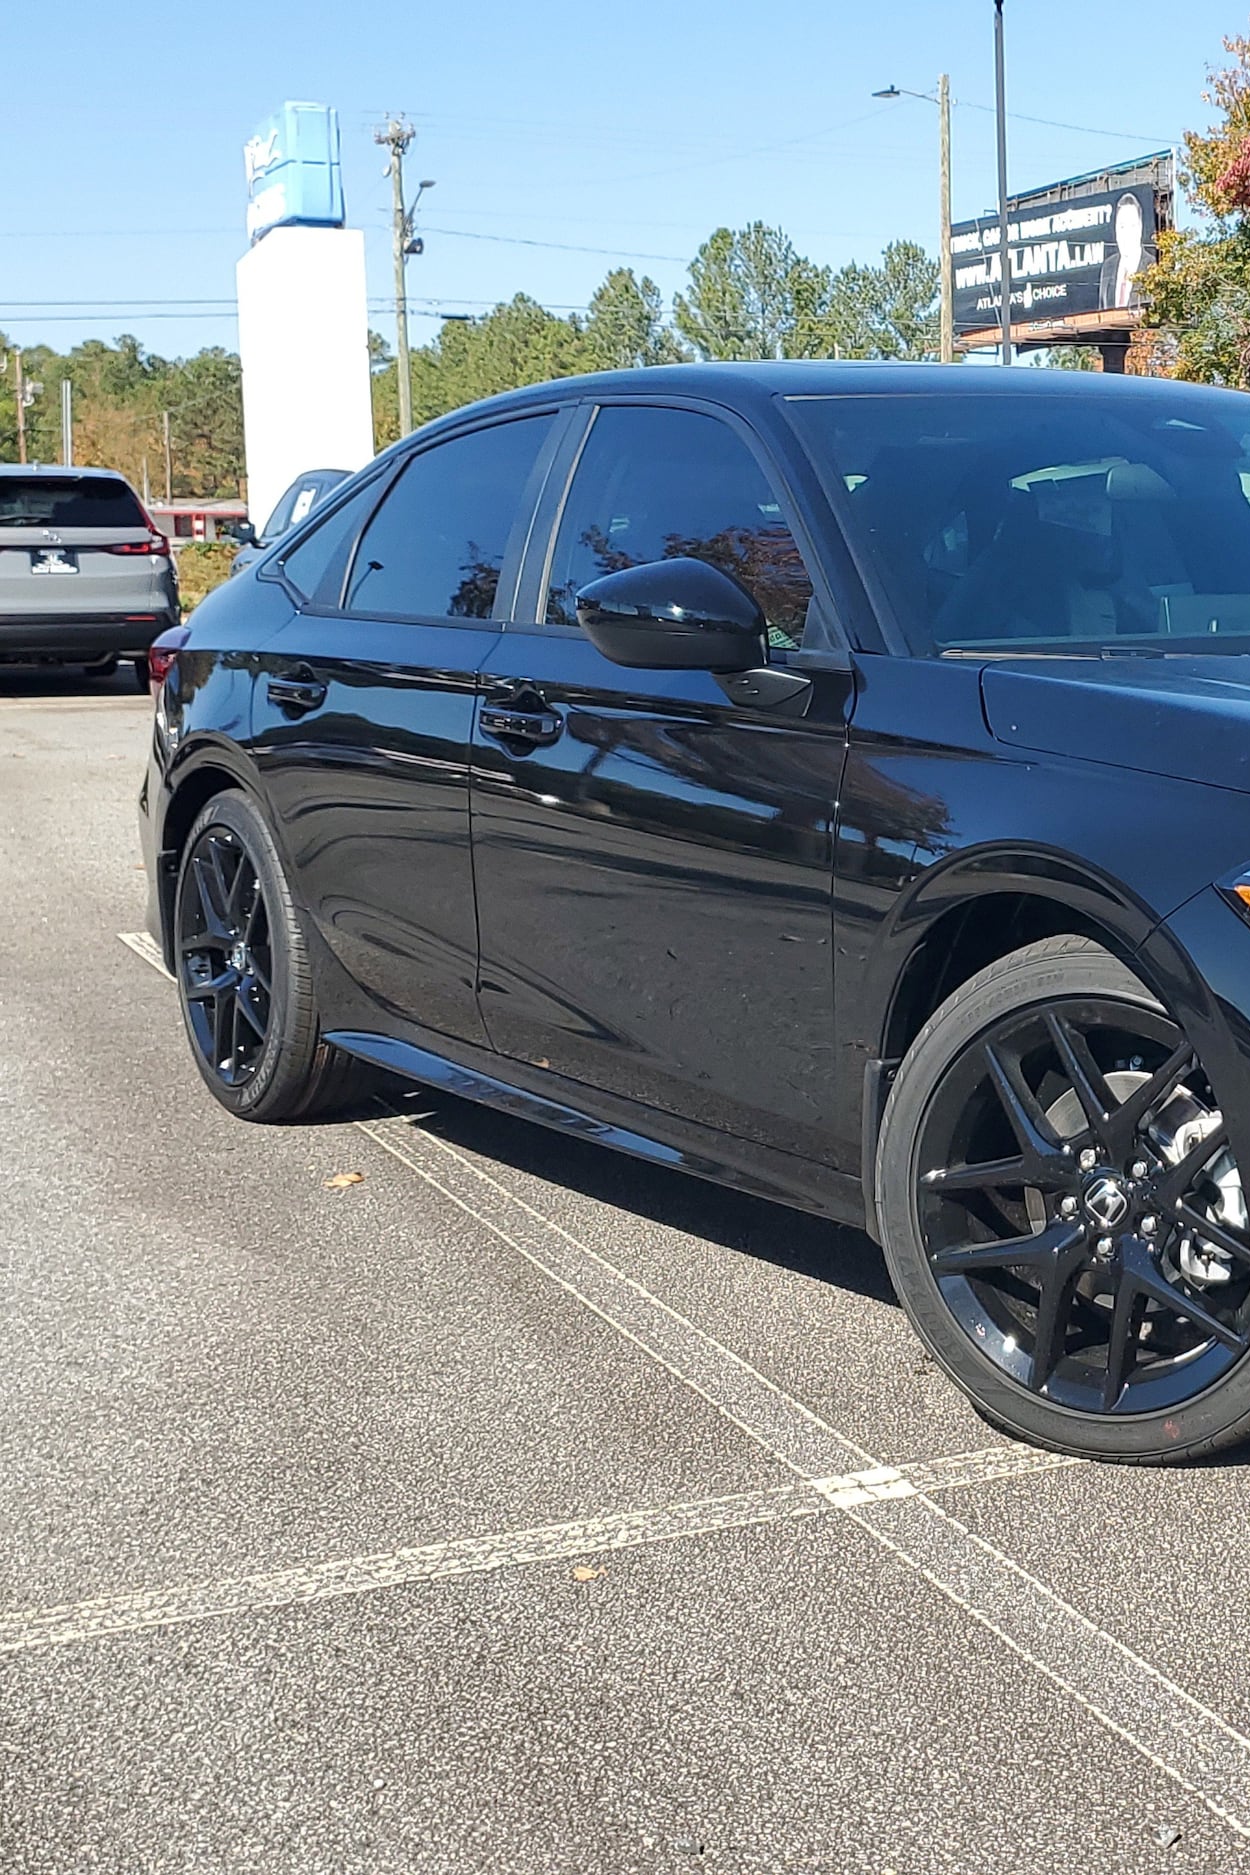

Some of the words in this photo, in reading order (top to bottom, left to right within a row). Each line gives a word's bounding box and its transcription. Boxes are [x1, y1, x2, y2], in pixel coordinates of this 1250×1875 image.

[1052, 204, 1113, 233] ACCIDENT?
[955, 240, 1105, 290] WWW.ALANTA.LAW
[976, 291, 1024, 311] ATLANA'S
[1032, 284, 1067, 301] CHOICE
